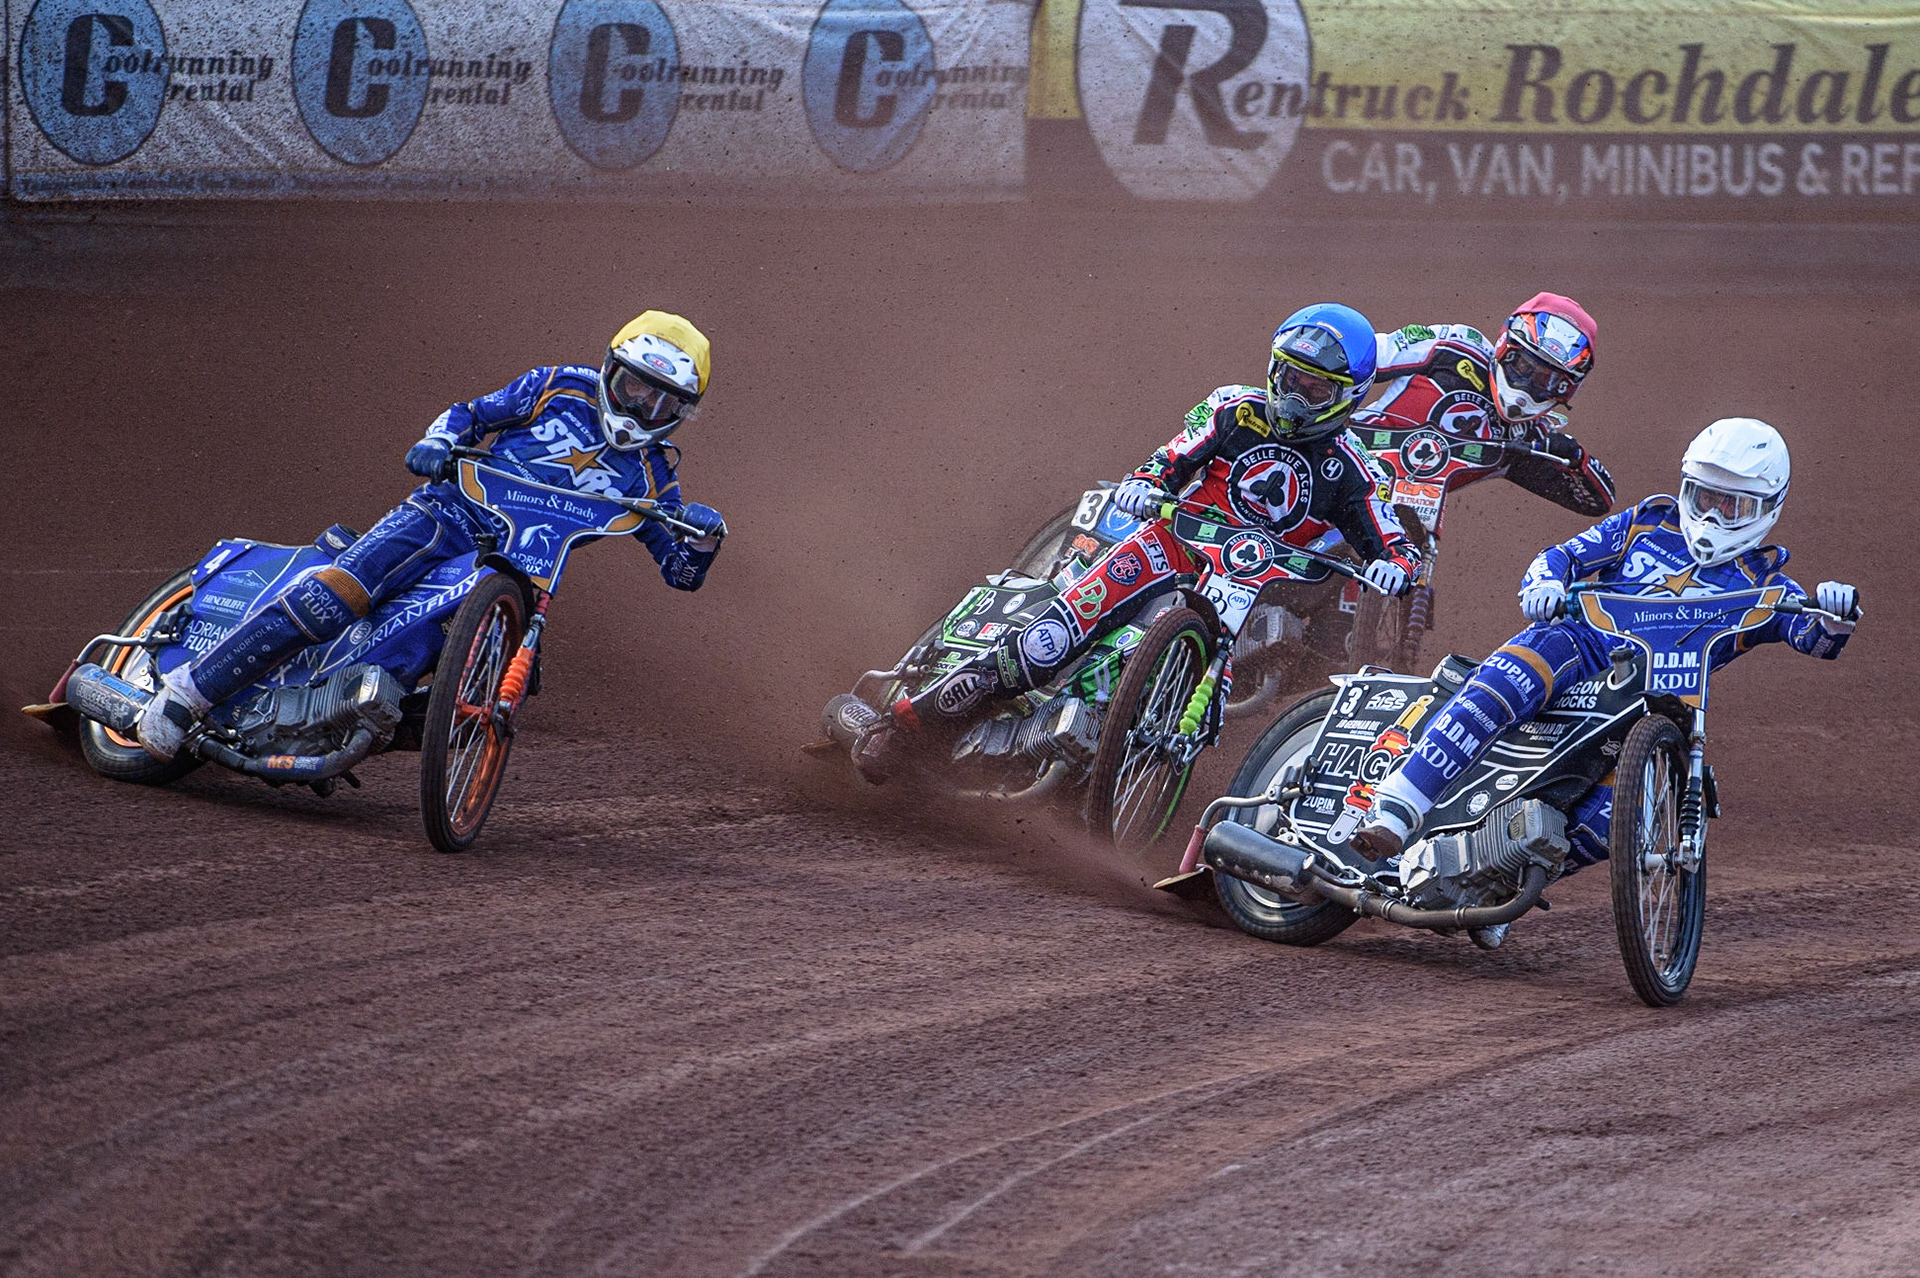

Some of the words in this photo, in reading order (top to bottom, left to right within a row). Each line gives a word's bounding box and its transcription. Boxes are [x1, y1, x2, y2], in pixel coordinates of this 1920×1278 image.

[166, 80, 255, 101] rental
[429, 82, 512, 105] rental
[1490, 42, 1920, 125] Rochdale
[680, 90, 764, 112] rental
[1322, 141, 1437, 204] CAR,
[1447, 143, 1567, 204] VAN,
[1581, 143, 1785, 197] MINIBUS
[1796, 143, 1831, 197] &
[1454, 393, 1482, 405] BELLE
[1404, 433, 1421, 447] BELLE
[1242, 450, 1276, 467] BELLE
[1281, 452, 1302, 470] VUE
[1299, 473, 1309, 503] ACES
[1326, 460, 1341, 478] 4
[504, 489, 545, 506] Minors
[546, 494, 561, 509] &
[563, 501, 598, 522] Brady
[1080, 494, 1103, 525] 3
[1229, 534, 1248, 546] BELLE
[1251, 534, 1264, 543] VUE
[1641, 537, 1667, 557] KING'S
[1666, 552, 1688, 566] LYNN
[204, 550, 231, 574] 4
[305, 580, 347, 624] ADRIAN
[425, 571, 480, 613] FLUX
[1231, 595, 1247, 605] ATPI
[300, 592, 331, 625] FLUX
[1632, 611, 1673, 623] Minors
[1675, 605, 1690, 620] &
[1694, 608, 1729, 623] Brady
[197, 652, 235, 684] BESPOKE
[233, 624, 274, 655] NORFOLK
[1036, 628, 1059, 656] ATPI
[1653, 652, 1700, 669] D.D.M.
[1485, 656, 1536, 694] ZUPIN
[1653, 673, 1699, 690] KDU
[1339, 687, 1363, 715] 3
[1436, 713, 1481, 760] D.D.M.
[1418, 735, 1462, 780] KDU
[1302, 795, 1336, 809] ZUPIN
